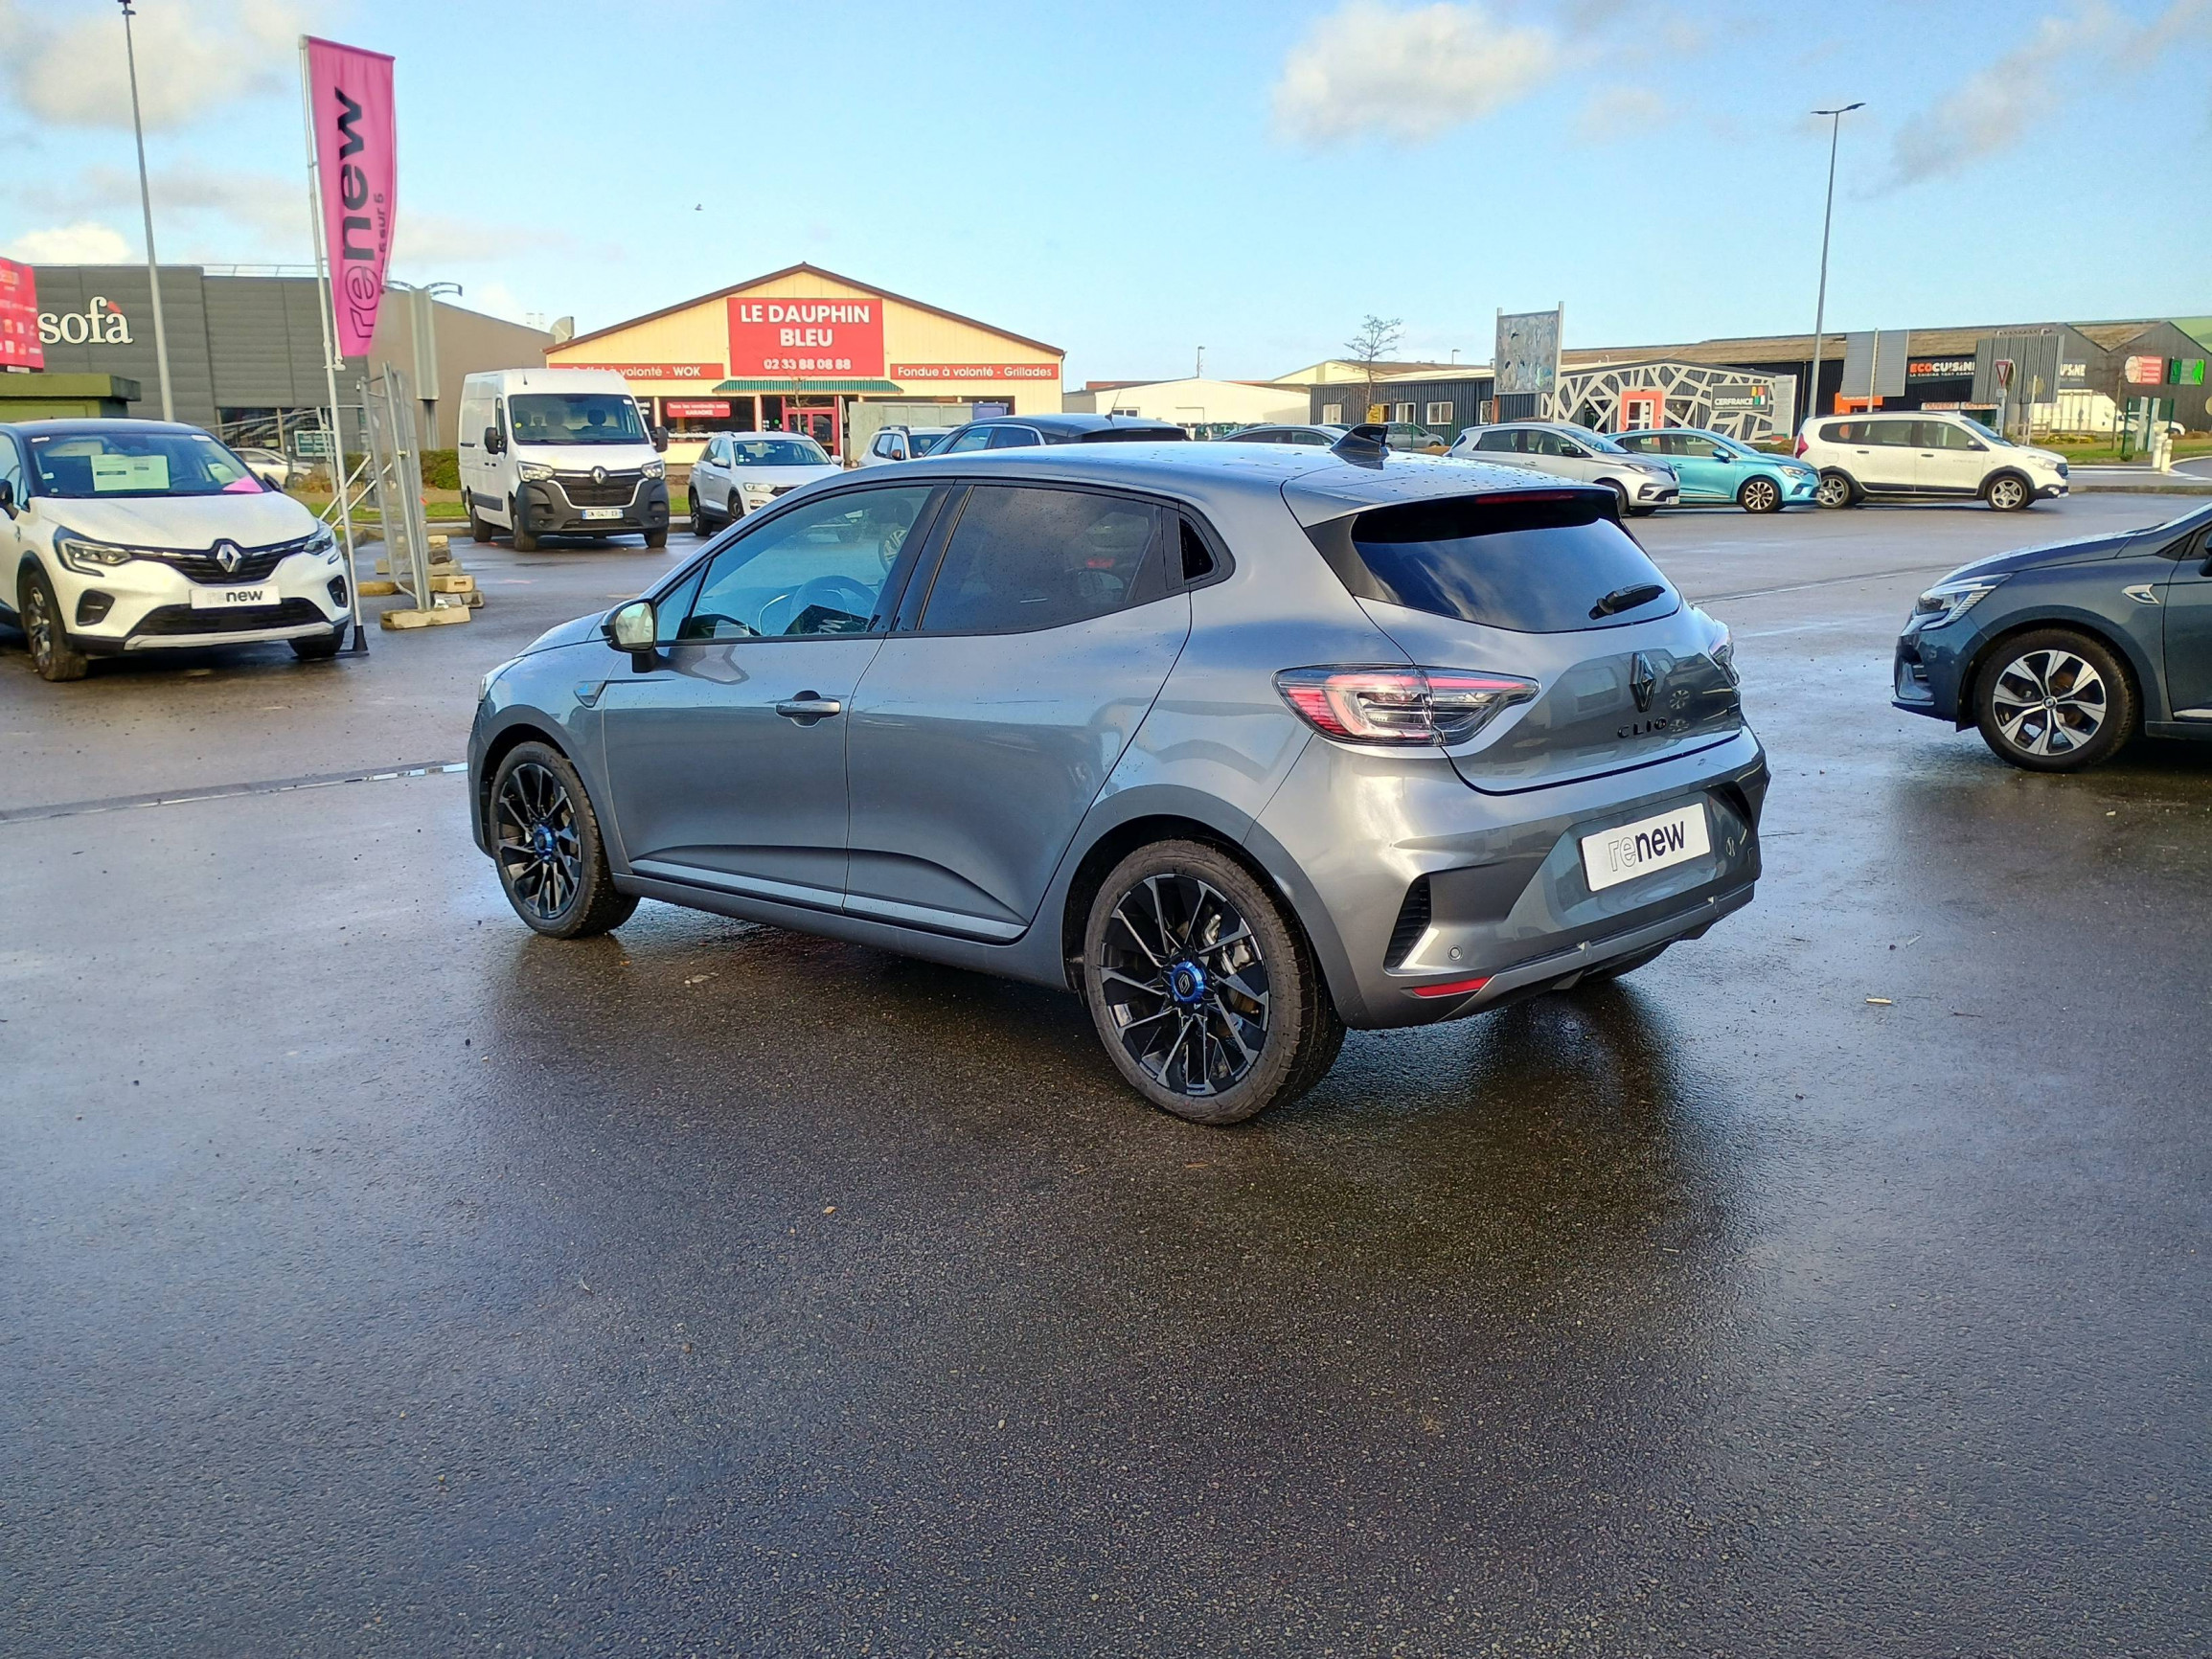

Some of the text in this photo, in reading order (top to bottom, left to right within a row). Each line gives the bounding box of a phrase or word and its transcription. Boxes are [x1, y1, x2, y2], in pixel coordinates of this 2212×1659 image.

[334, 85, 379, 338] renew
[741, 305, 870, 323] LE DAUPHIN
[780, 329, 833, 347] BLEU
[621, 366, 663, 378] volonté
[673, 366, 701, 376] WOK
[764, 359, 779, 370] 02
[781, 358, 797, 370] 33
[898, 367, 939, 376] Fondue
[943, 366, 950, 376] à
[954, 366, 993, 376] volonté
[1004, 367, 1052, 376] Grillades
[1715, 398, 1753, 406] CERFRANCE
[1617, 716, 1667, 739] CLIO
[1608, 821, 1684, 872] renew
